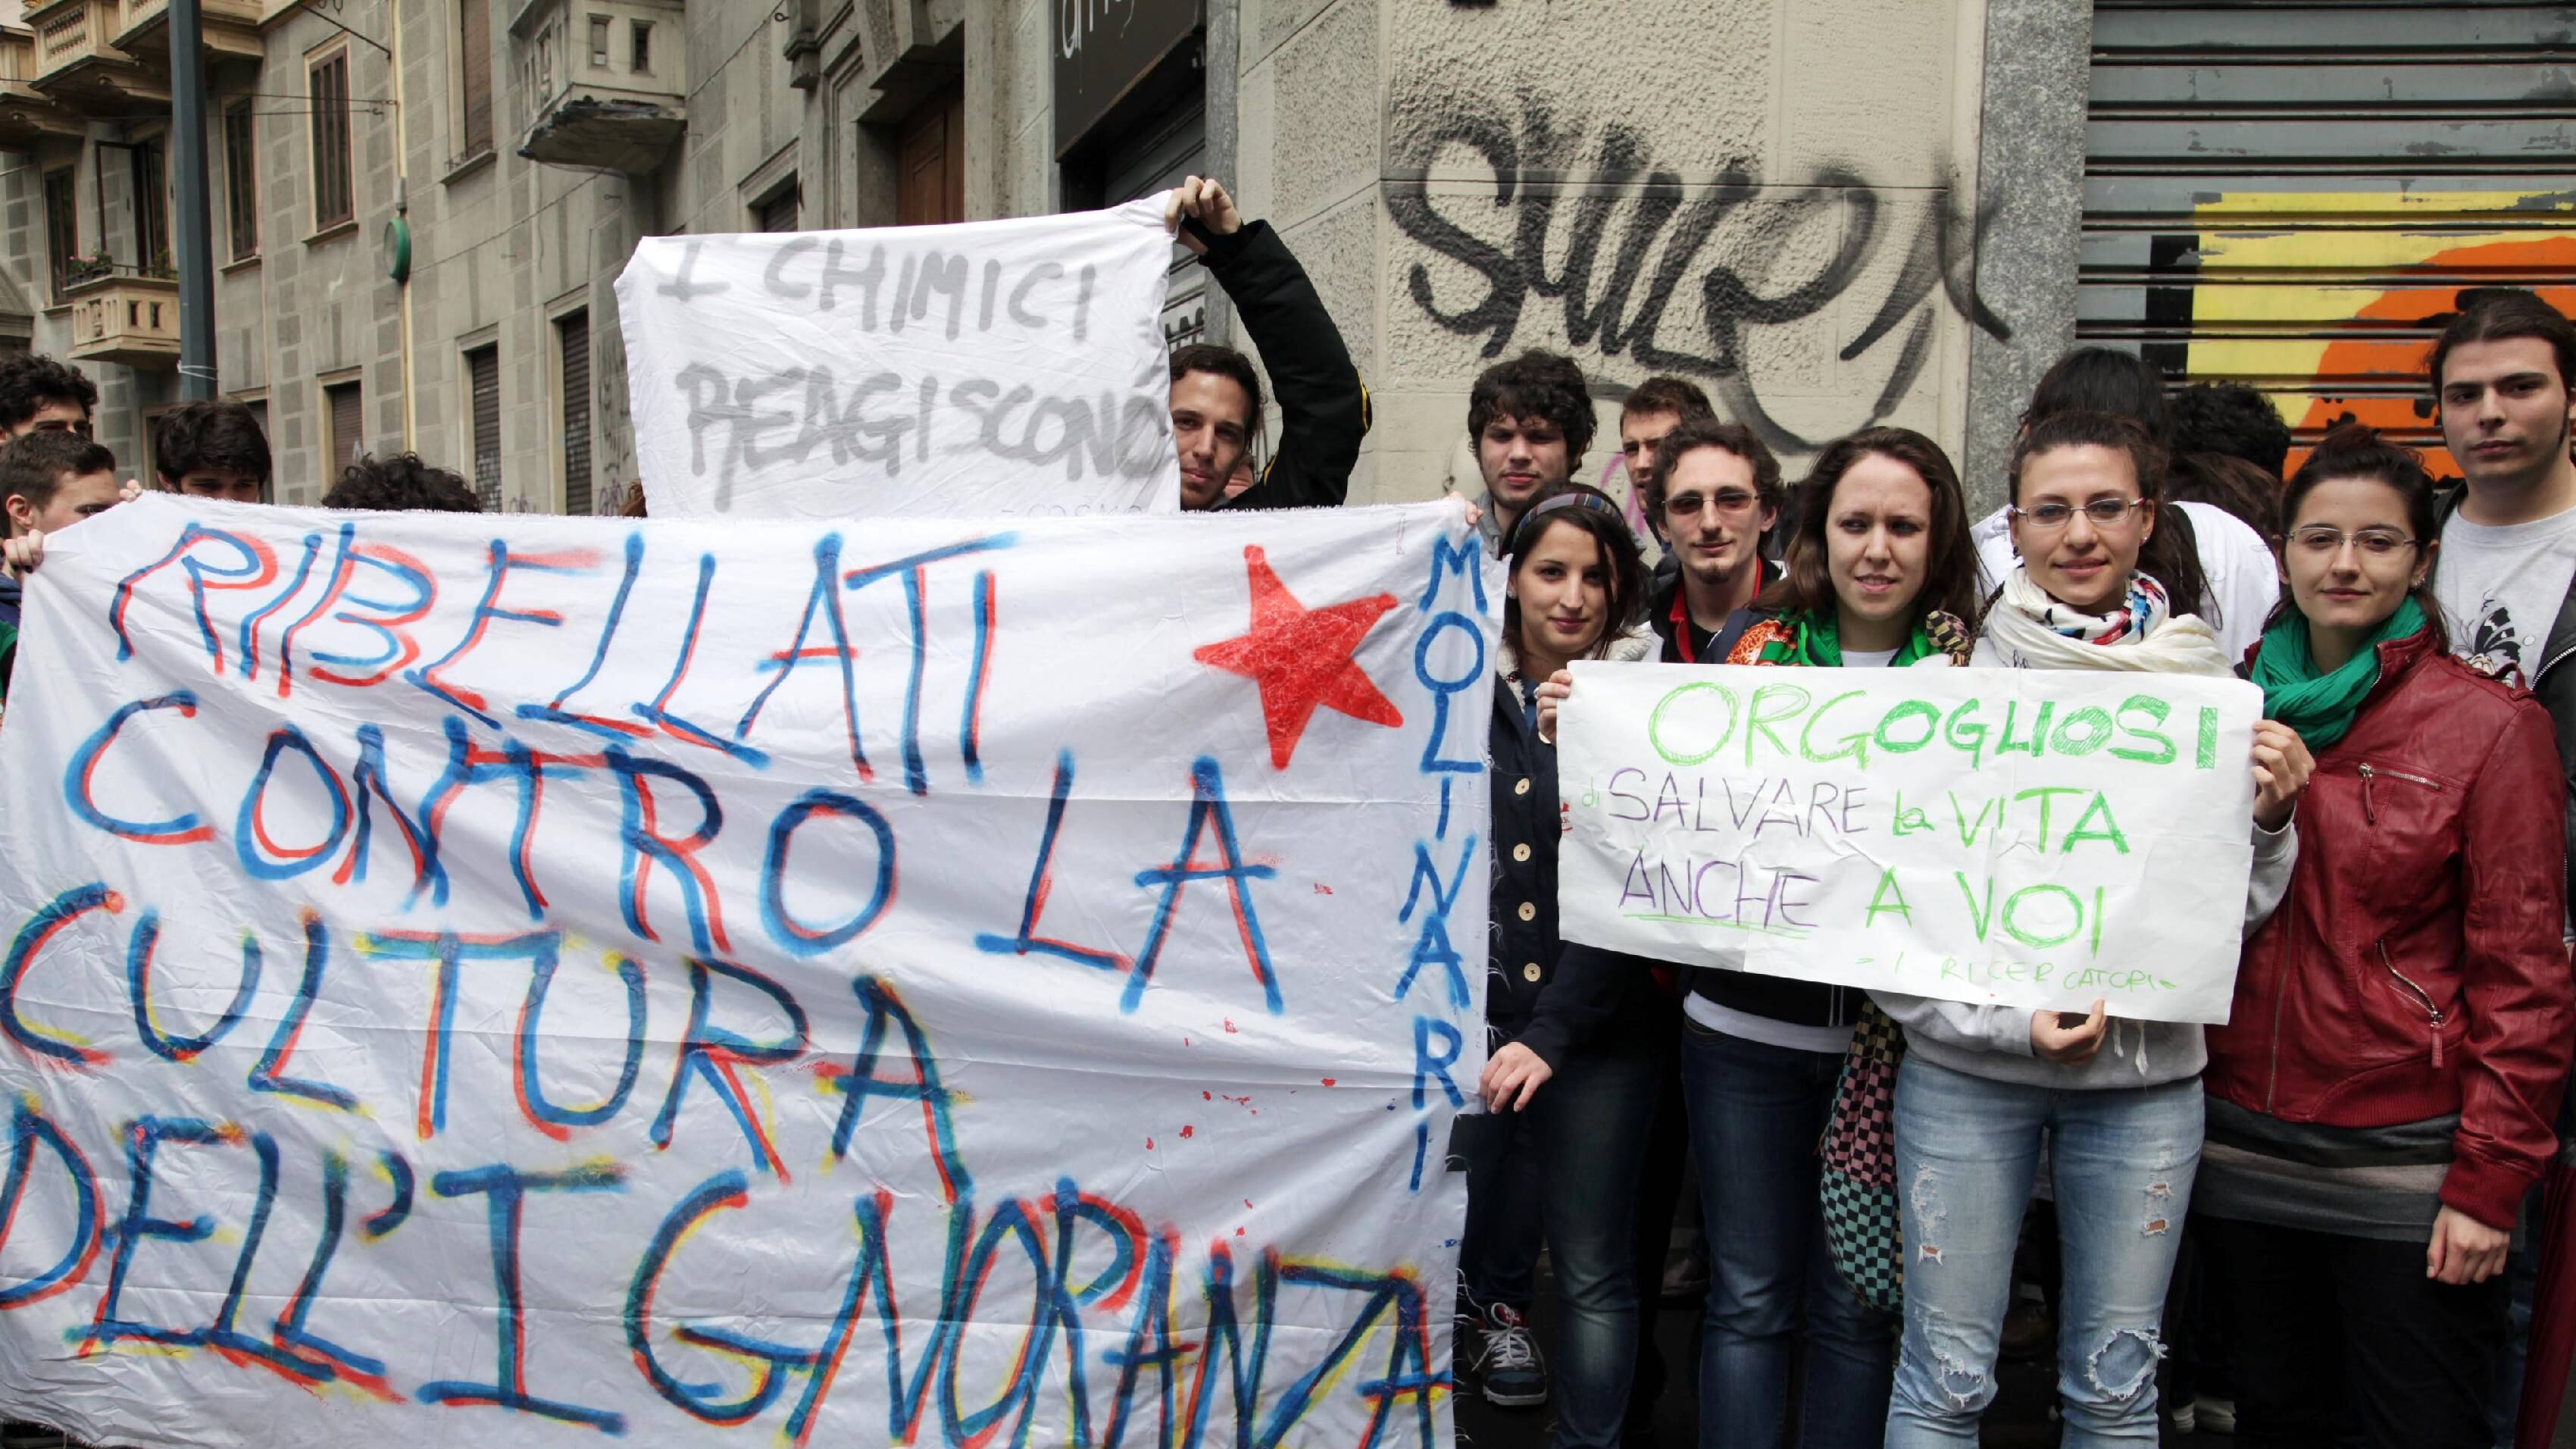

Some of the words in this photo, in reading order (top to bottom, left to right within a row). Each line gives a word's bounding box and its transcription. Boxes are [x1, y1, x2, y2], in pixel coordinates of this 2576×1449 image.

[656, 238, 730, 302] I
[764, 236, 1097, 342] CHIMICI
[676, 362, 1171, 512] REAGISCONO
[109, 521, 1020, 796] RIBELLATI
[1648, 681, 2218, 769] ORGOGLIOSI
[63, 688, 897, 953] CONTRO
[975, 749, 1284, 1014] LA
[1394, 534, 1487, 1192] MOLINARI
[1608, 767, 1868, 838] SALVARE
[1892, 790, 1934, 835] la
[1949, 787, 2130, 854] VITA
[1618, 846, 1819, 929] ANCHE
[1867, 866, 1912, 928] A
[1956, 871, 2103, 958] VOI
[0, 881, 975, 1205] CULTURA
